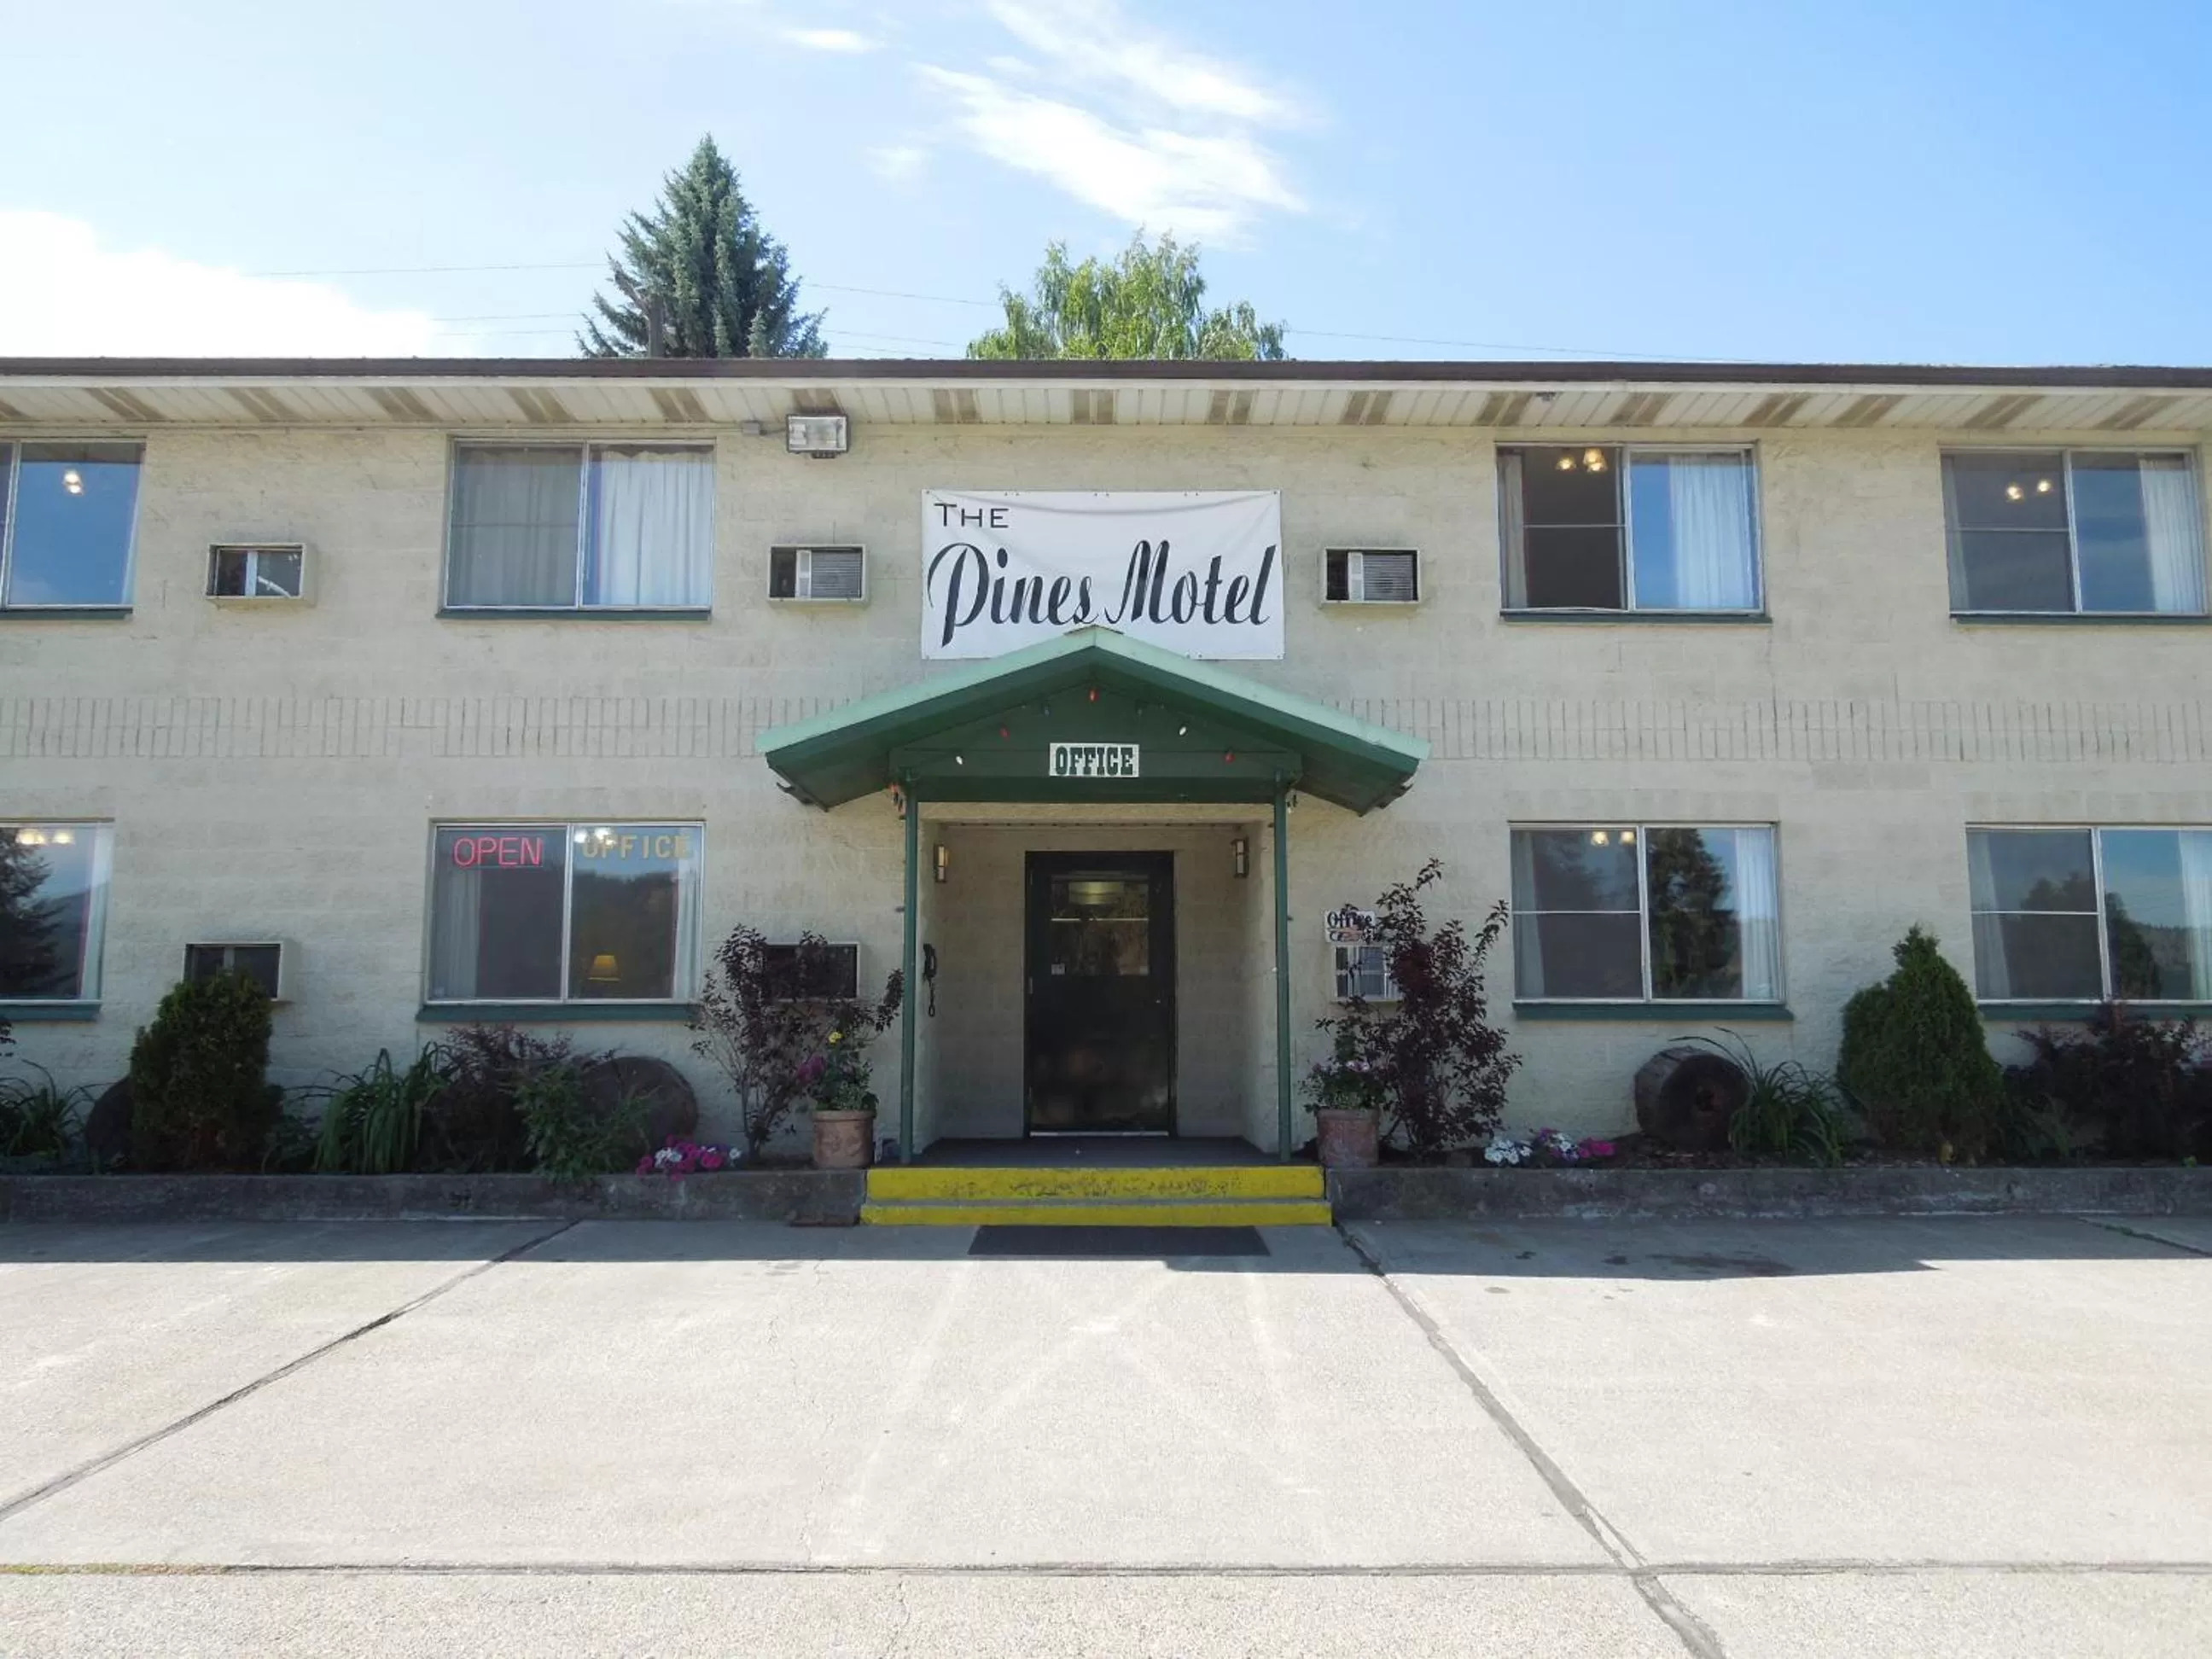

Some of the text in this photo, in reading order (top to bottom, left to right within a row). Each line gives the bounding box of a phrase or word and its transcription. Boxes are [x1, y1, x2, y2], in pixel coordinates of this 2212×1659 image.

[934, 503, 1010, 528] THE
[927, 539, 1277, 649] Pines Motel
[1055, 746, 1134, 776] OFFICE
[453, 836, 544, 870] OPEN
[582, 834, 692, 859] OFFICE
